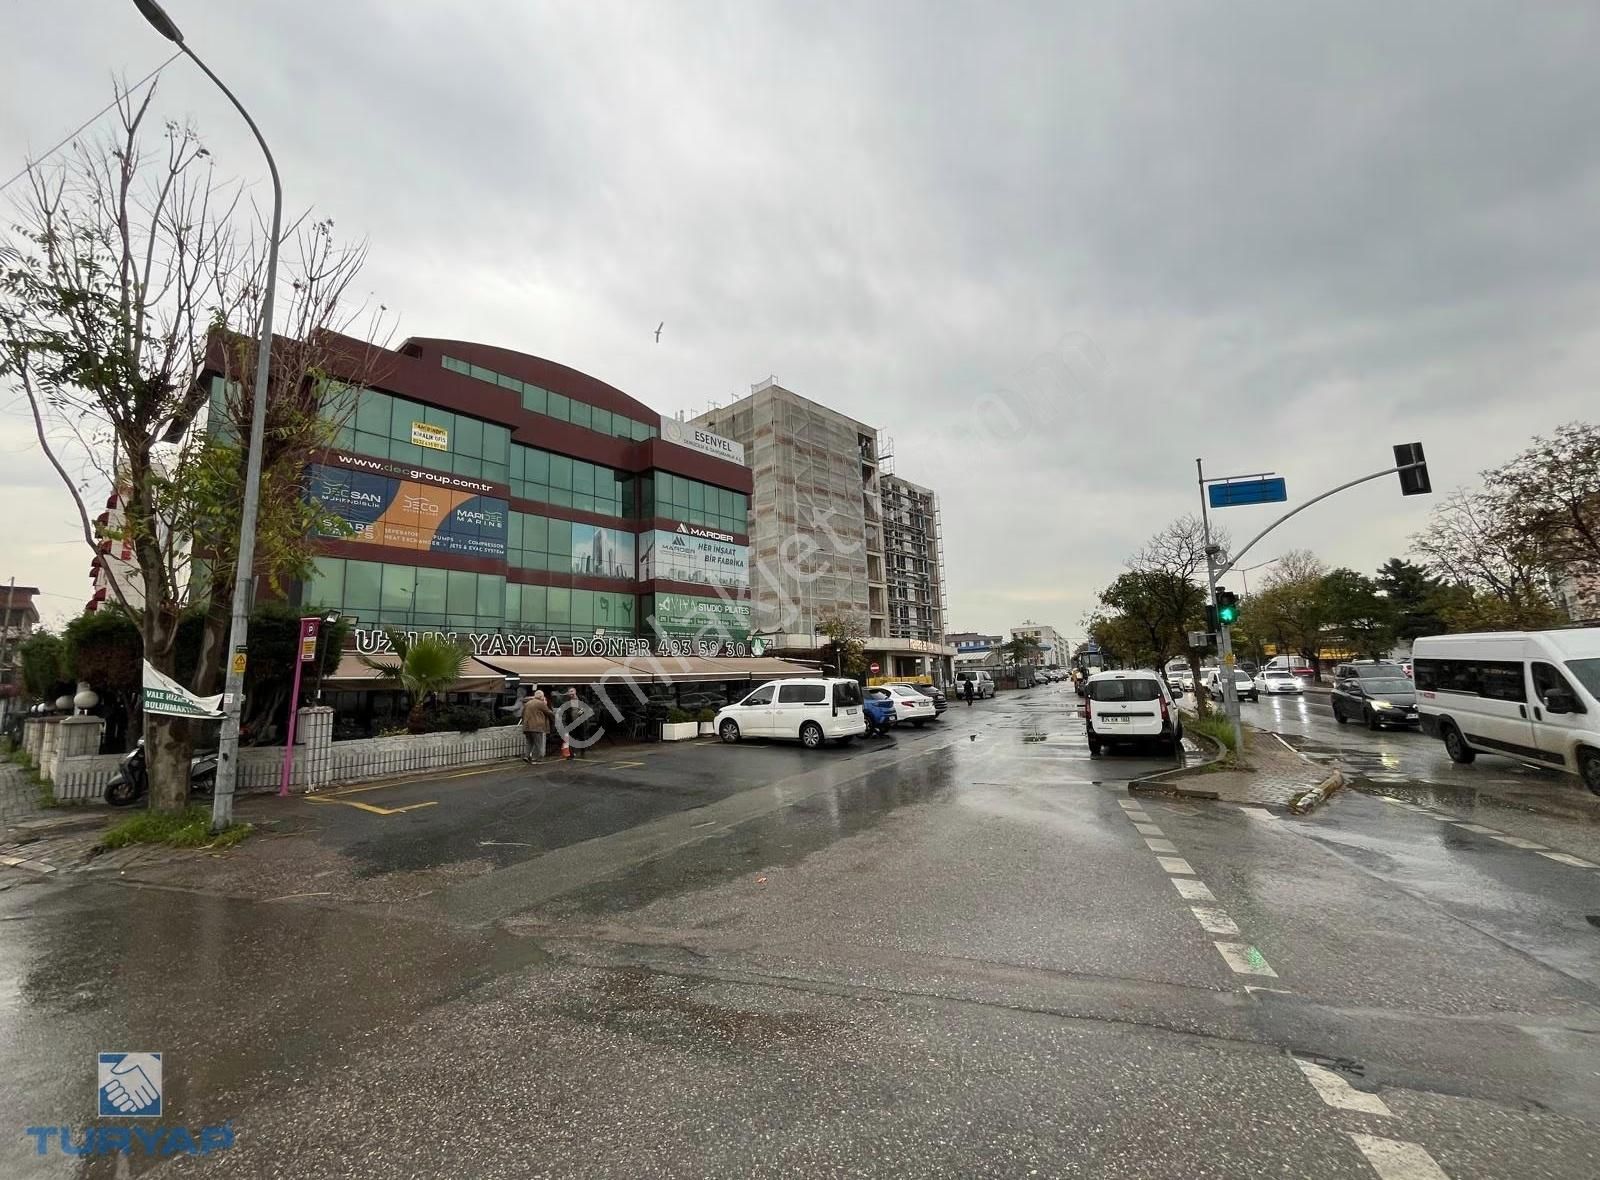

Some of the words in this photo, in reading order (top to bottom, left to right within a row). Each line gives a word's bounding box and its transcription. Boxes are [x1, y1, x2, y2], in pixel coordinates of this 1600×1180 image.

[694, 431, 732, 452] ESENYEL
[339, 455, 493, 492] www.decgroup.com.tr
[322, 518, 375, 533] SRE
[457, 516, 502, 528] MARINE
[690, 527, 734, 542] MARDER
[468, 539, 504, 549] COMPRESSOR
[698, 543, 712, 552] HER
[704, 554, 716, 563] BİR
[698, 603, 722, 613] STUDIO
[724, 605, 750, 615] PILATES
[469, 634, 561, 656] YAYLA
[572, 634, 650, 657] DÖNER
[657, 639, 692, 657] 493
[699, 640, 719, 657] 59
[726, 641, 746, 657] 30
[146, 690, 164, 700] VALE
